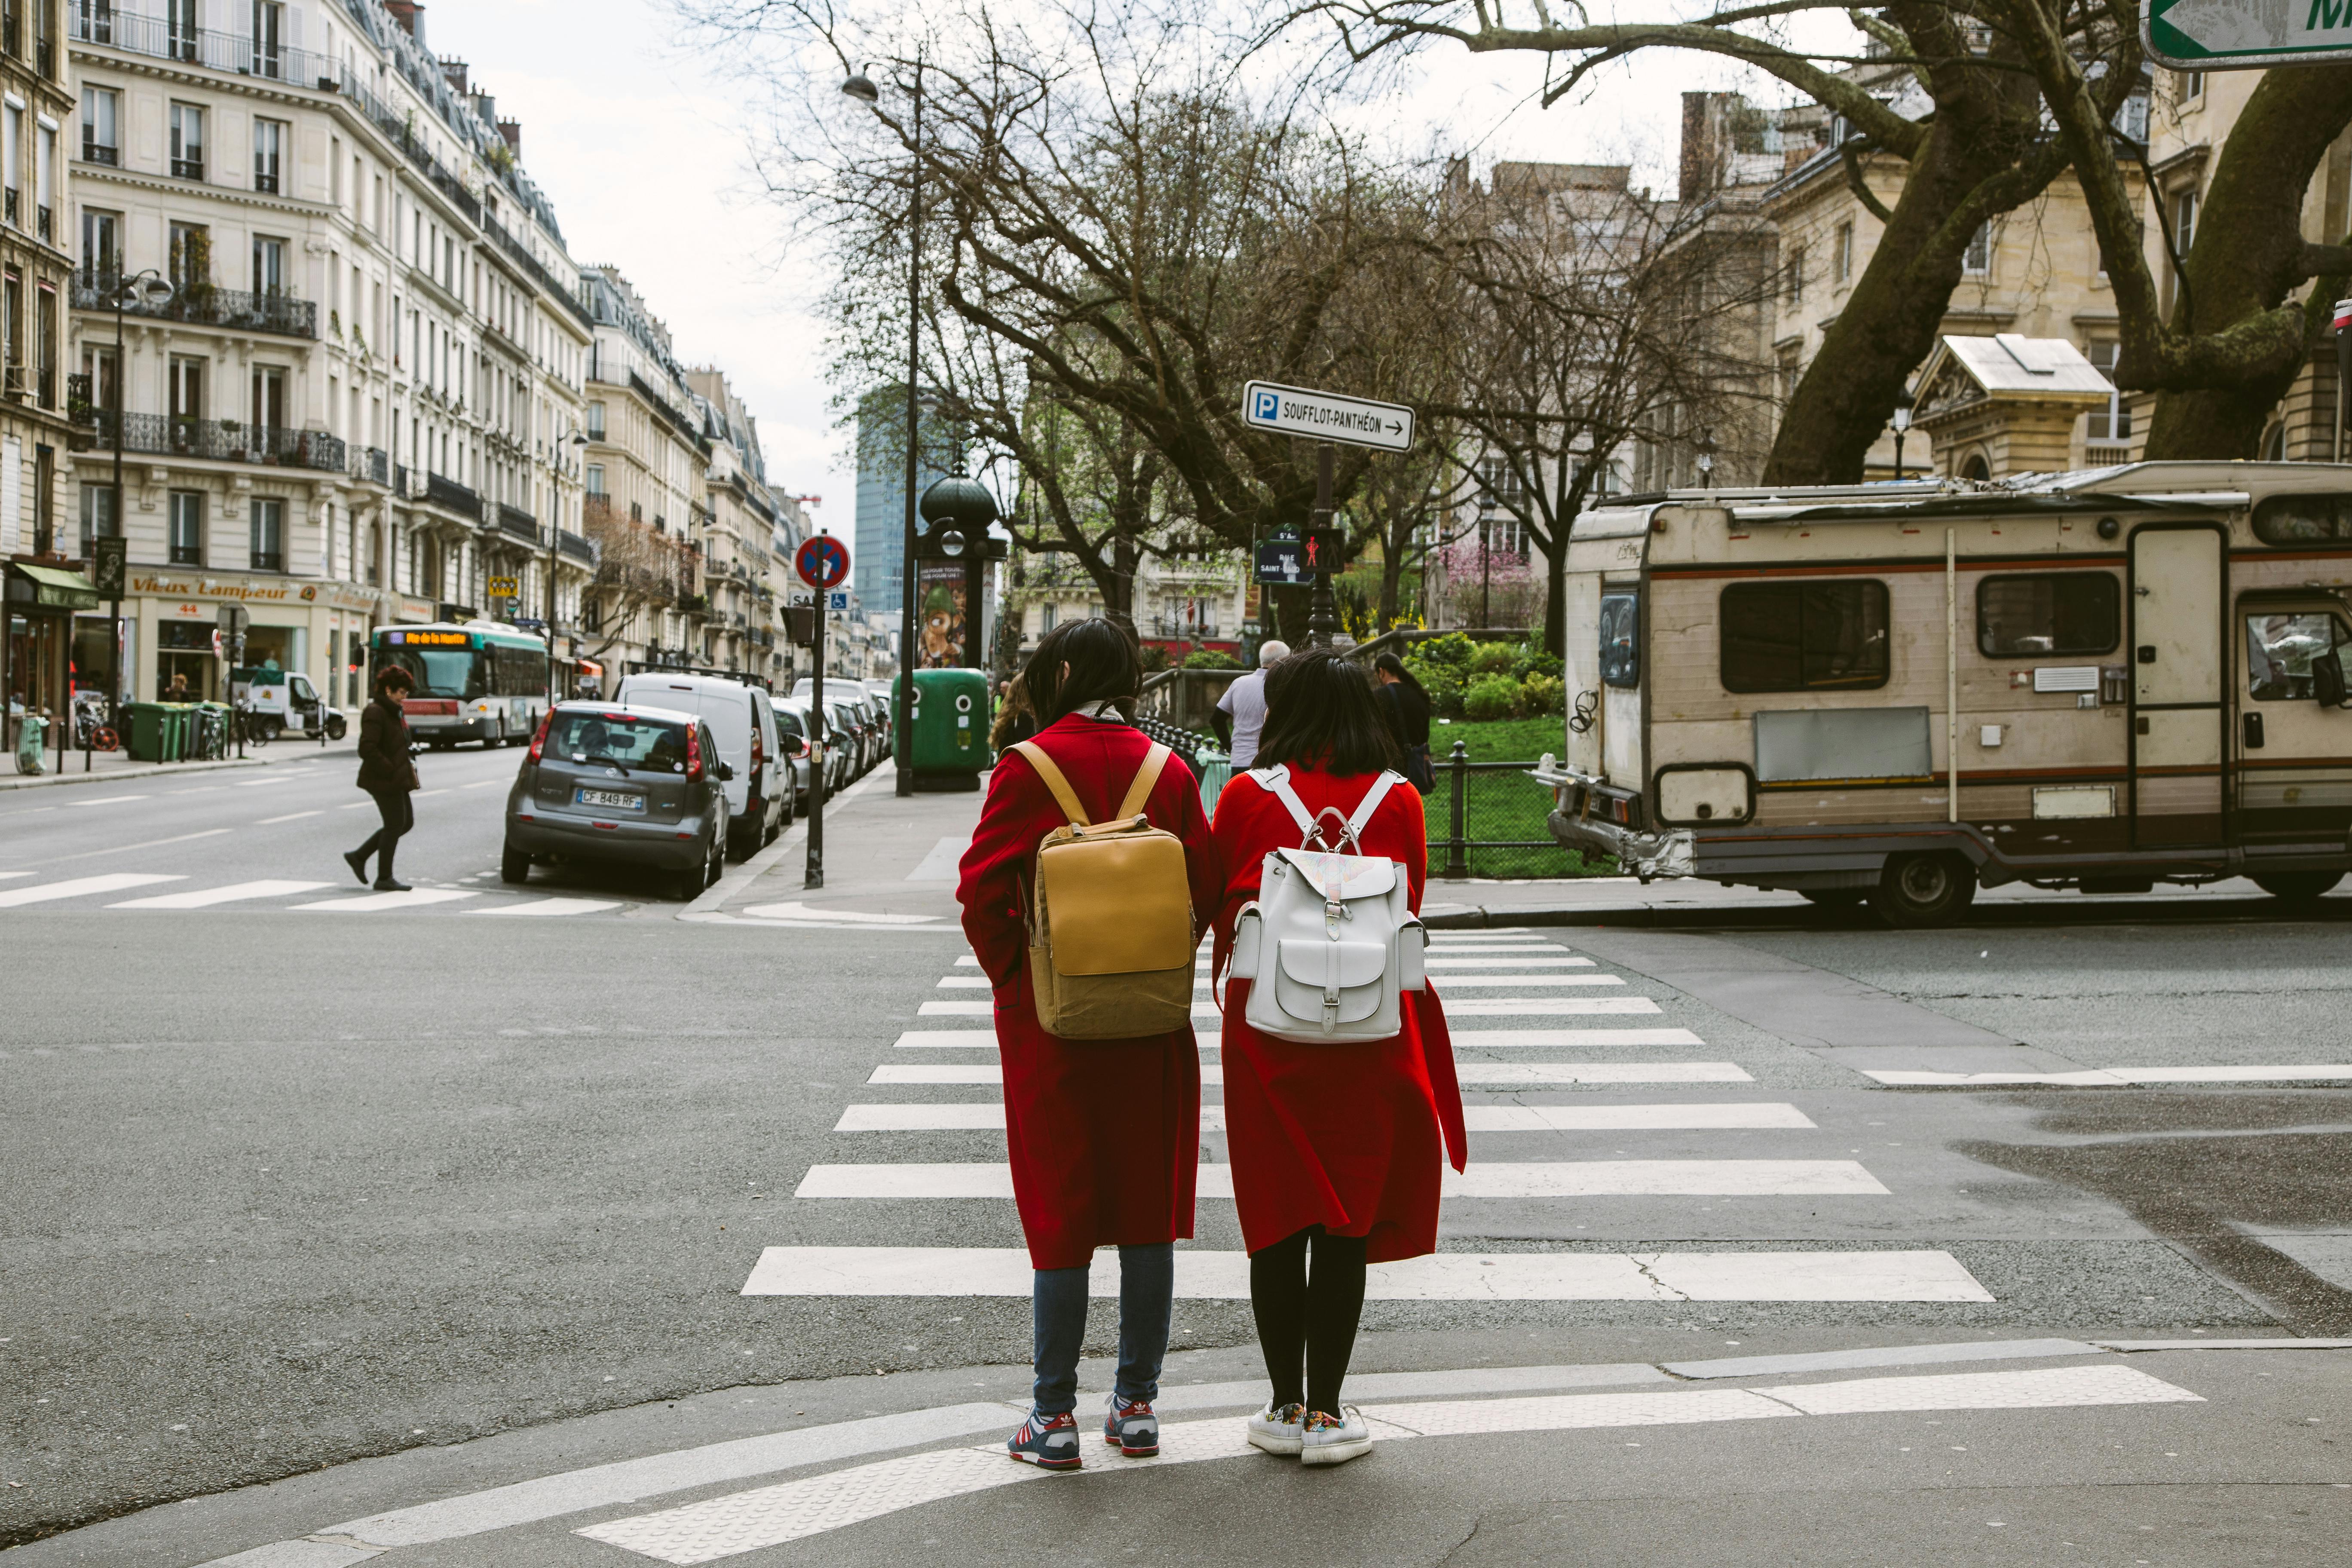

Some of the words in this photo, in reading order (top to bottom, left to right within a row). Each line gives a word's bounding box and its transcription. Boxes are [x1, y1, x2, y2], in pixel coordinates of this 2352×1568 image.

[1283, 401, 1381, 433] SOUFFLOT-PANTHÉON
[793, 595, 828, 606] SAF
[179, 603, 197, 613] 44
